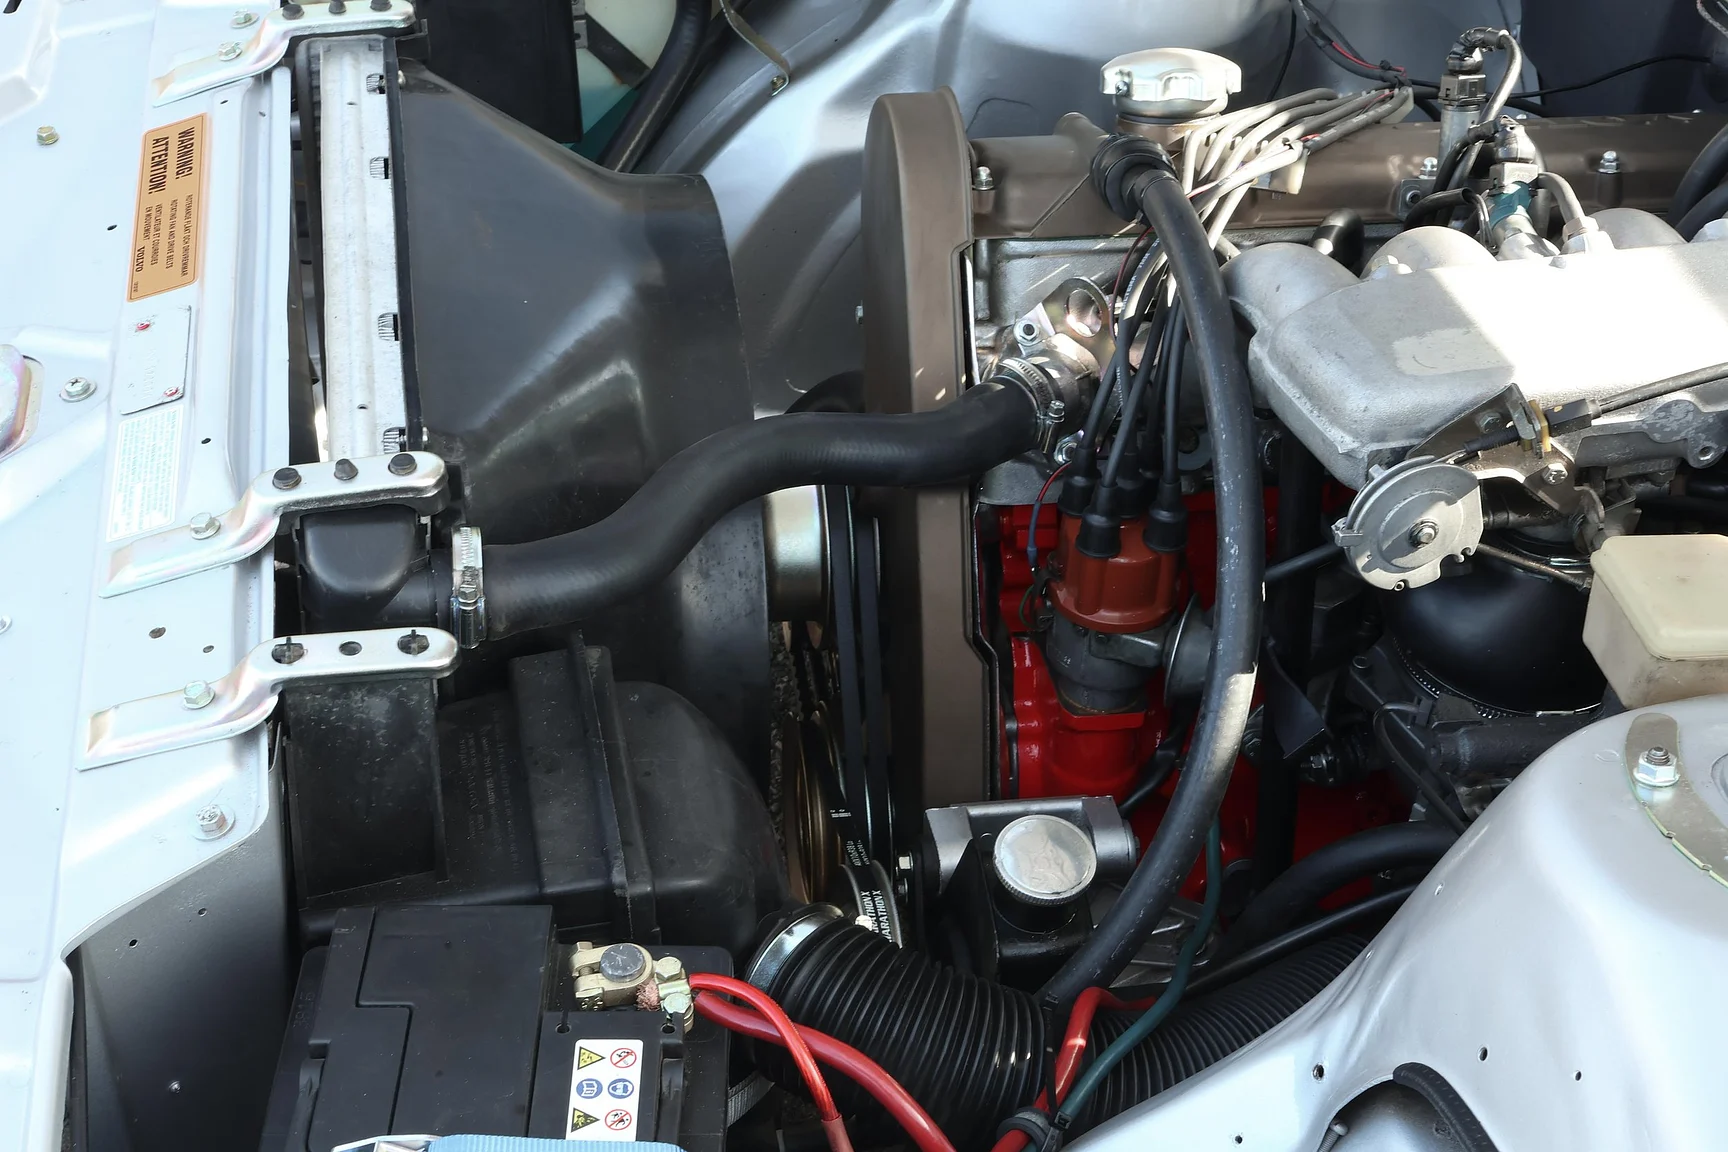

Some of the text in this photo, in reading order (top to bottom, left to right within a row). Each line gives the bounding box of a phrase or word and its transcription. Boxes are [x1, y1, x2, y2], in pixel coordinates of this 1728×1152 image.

[148, 136, 169, 194] ATTENTION!
[175, 127, 195, 179] WARNING!
[154, 204, 162, 233] VENTILATEUR
[170, 199, 178, 220] ROTATING
[184, 194, 193, 220] ROTERANDE
[143, 213, 152, 240] MOUVEMENT
[135, 246, 145, 272] VOLVO
[151, 239, 160, 265] COURROIES
[167, 240, 175, 254] DRIVE
[166, 255, 174, 269] BELTS
[862, 895, 880, 933] RATHON
